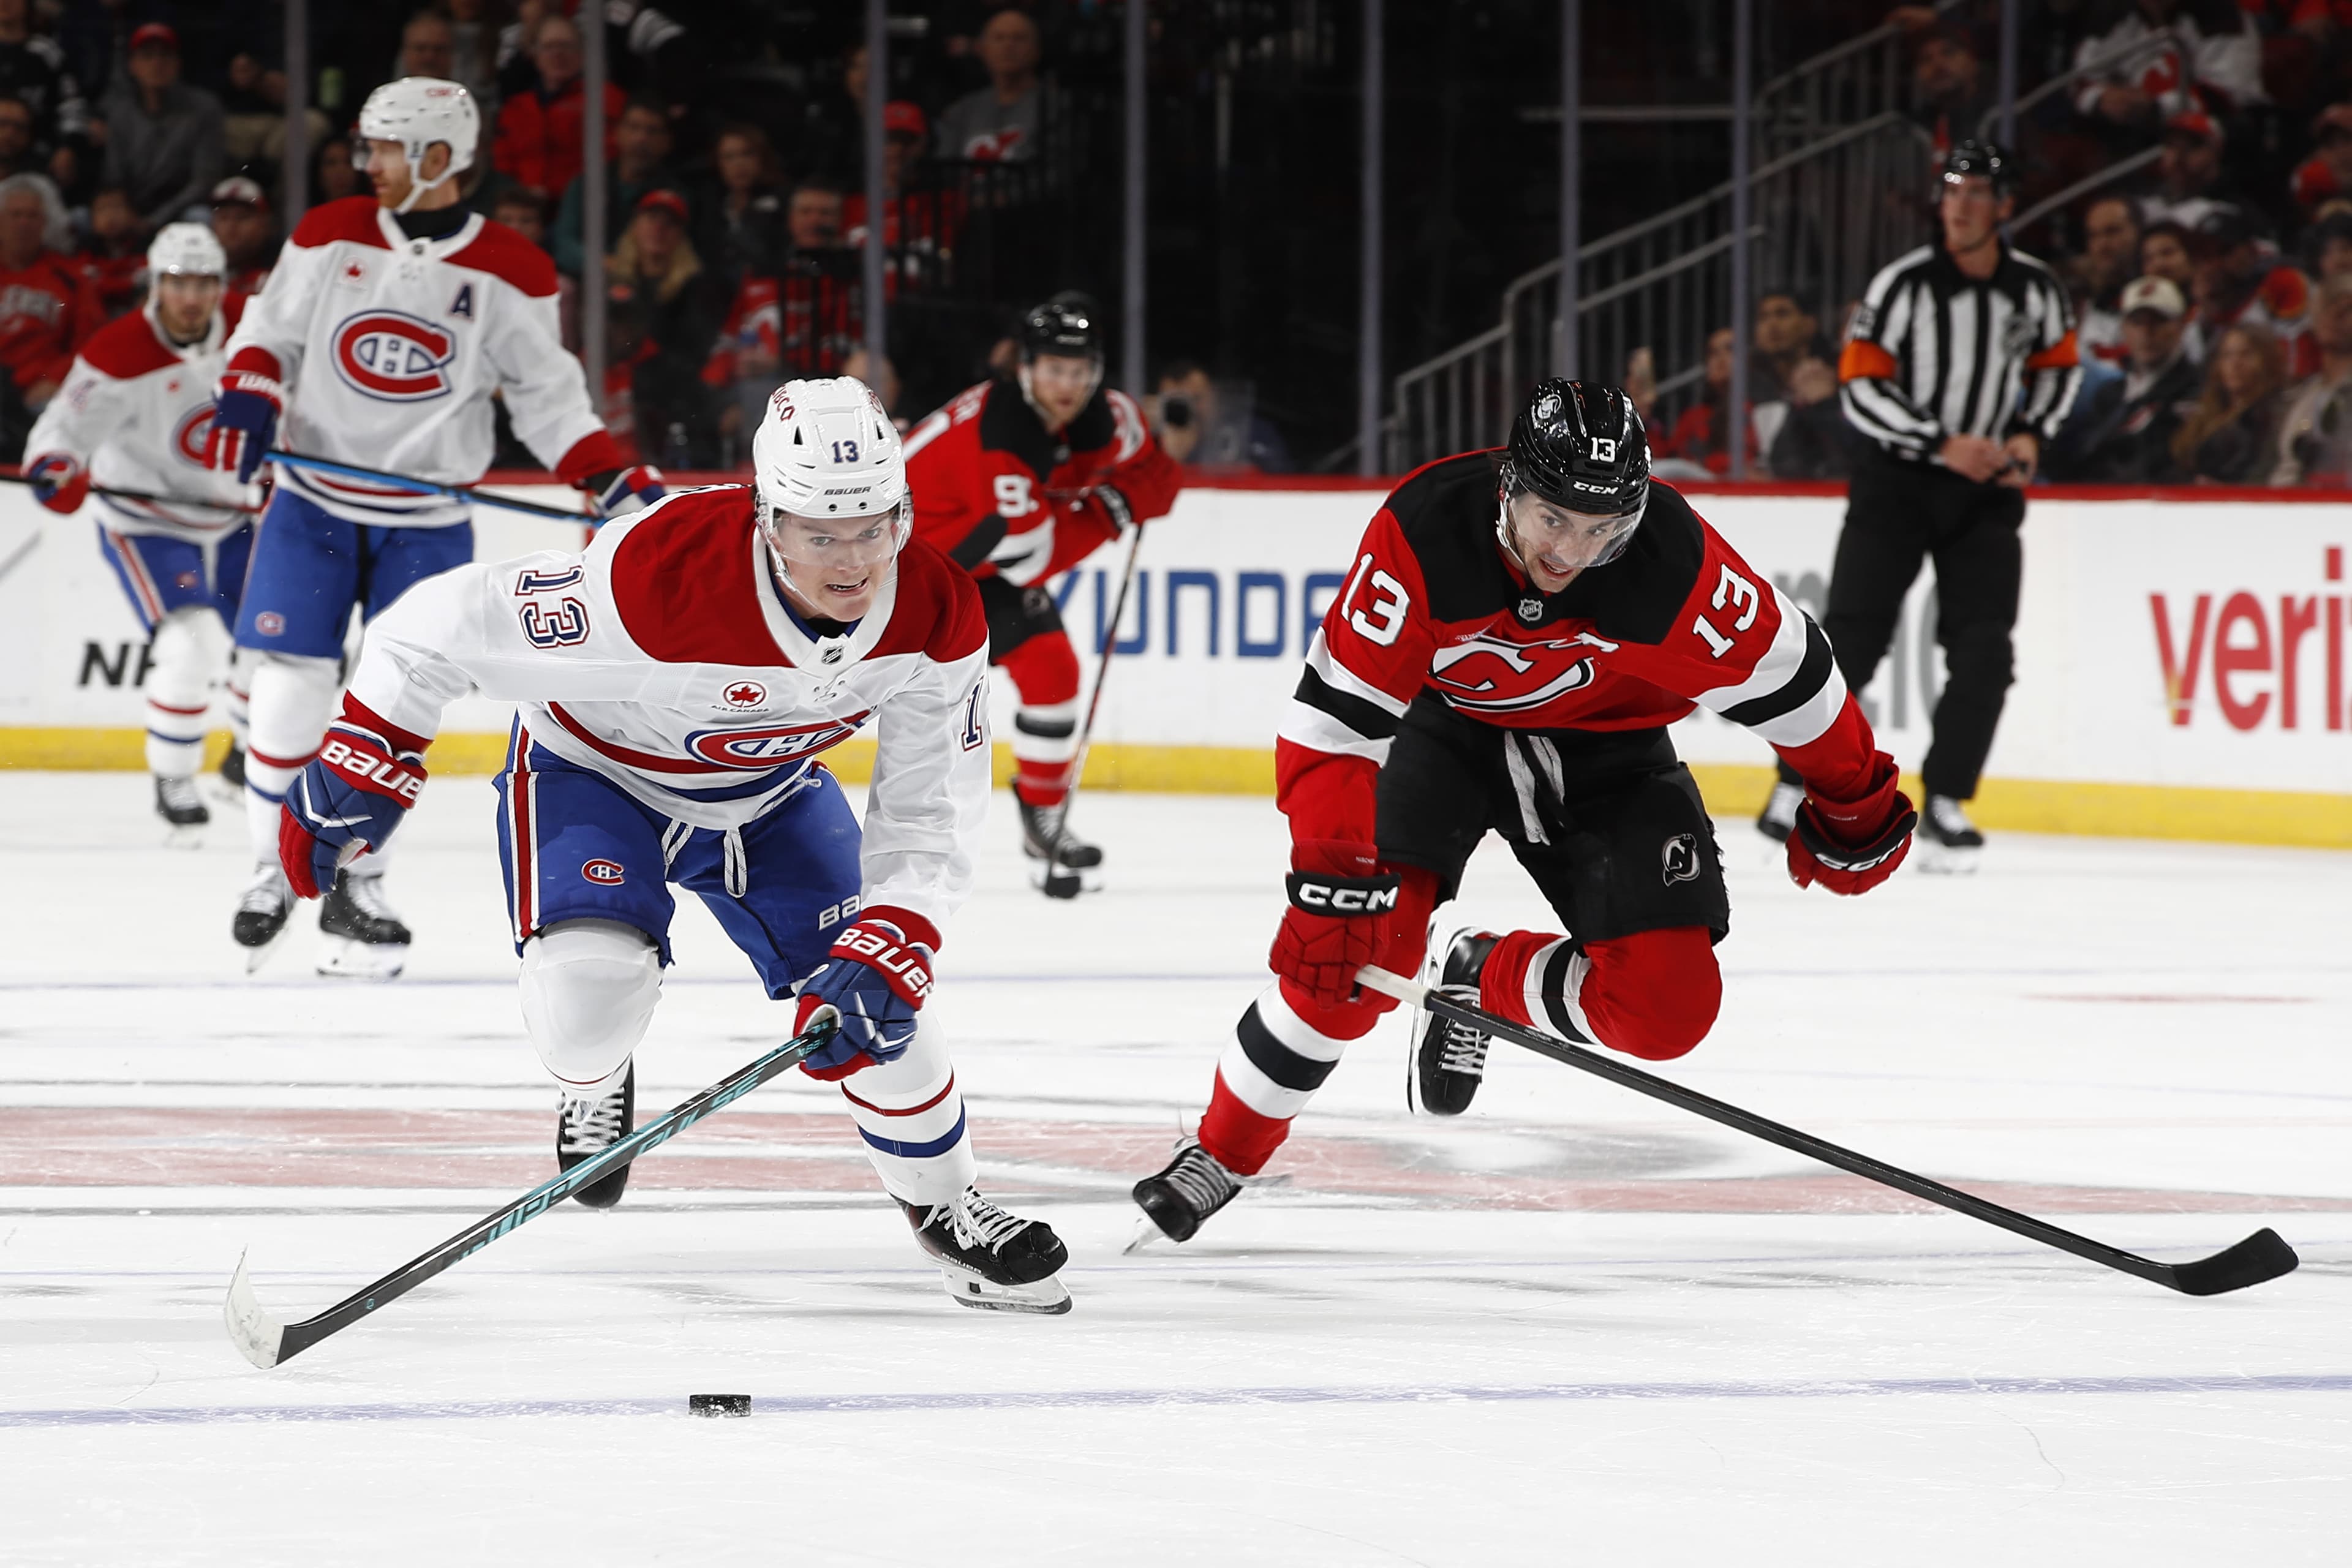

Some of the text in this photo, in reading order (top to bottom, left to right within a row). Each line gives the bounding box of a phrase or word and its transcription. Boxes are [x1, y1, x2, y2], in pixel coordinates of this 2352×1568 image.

[448, 282, 474, 322] A
[831, 440, 859, 464] 13
[1591, 437, 1616, 462] 13
[824, 486, 872, 496] BAUER
[993, 474, 1039, 518] 9
[1573, 481, 1619, 494] CCM
[515, 565, 590, 649] 13
[1341, 553, 1411, 647] 13
[1692, 563, 1759, 658] 13
[2149, 545, 2352, 732] veri
[962, 674, 991, 752] 1
[319, 741, 426, 801] BAUE
[819, 894, 861, 930] BA
[1298, 881, 1398, 912] CCM
